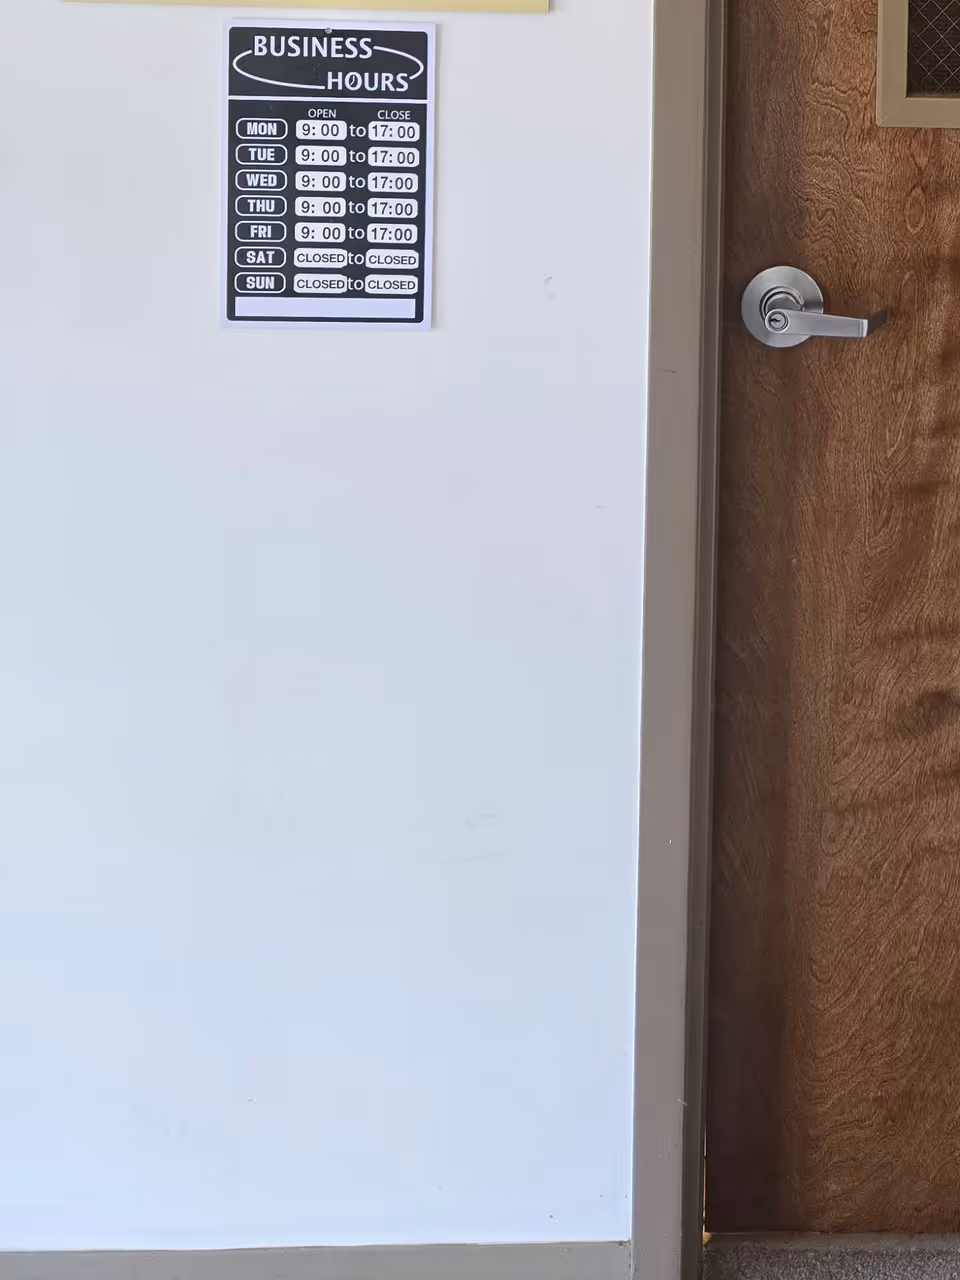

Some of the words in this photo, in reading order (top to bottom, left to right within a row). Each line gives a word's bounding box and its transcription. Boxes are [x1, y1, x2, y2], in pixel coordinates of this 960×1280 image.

[254, 35, 372, 59] BUSINESS
[327, 72, 409, 91] HOURS
[308, 109, 336, 118] OPEN
[378, 110, 411, 120] CLOSE
[247, 123, 277, 136] MON
[349, 124, 366, 137] to
[249, 148, 274, 161] TUE
[349, 150, 366, 162] to
[246, 174, 277, 187] WED
[349, 176, 365, 188] to
[248, 200, 275, 212] THU
[348, 201, 365, 213] to
[250, 225, 271, 238] FRI
[348, 226, 365, 239] to
[246, 251, 274, 263] SAT
[297, 253, 346, 263] CLOSED
[348, 252, 364, 264] to
[369, 254, 416, 265] CLOSED
[246, 277, 274, 289] SUN
[296, 279, 345, 289] CLOSED
[347, 277, 364, 290] to
[368, 279, 415, 290] CLOSED
